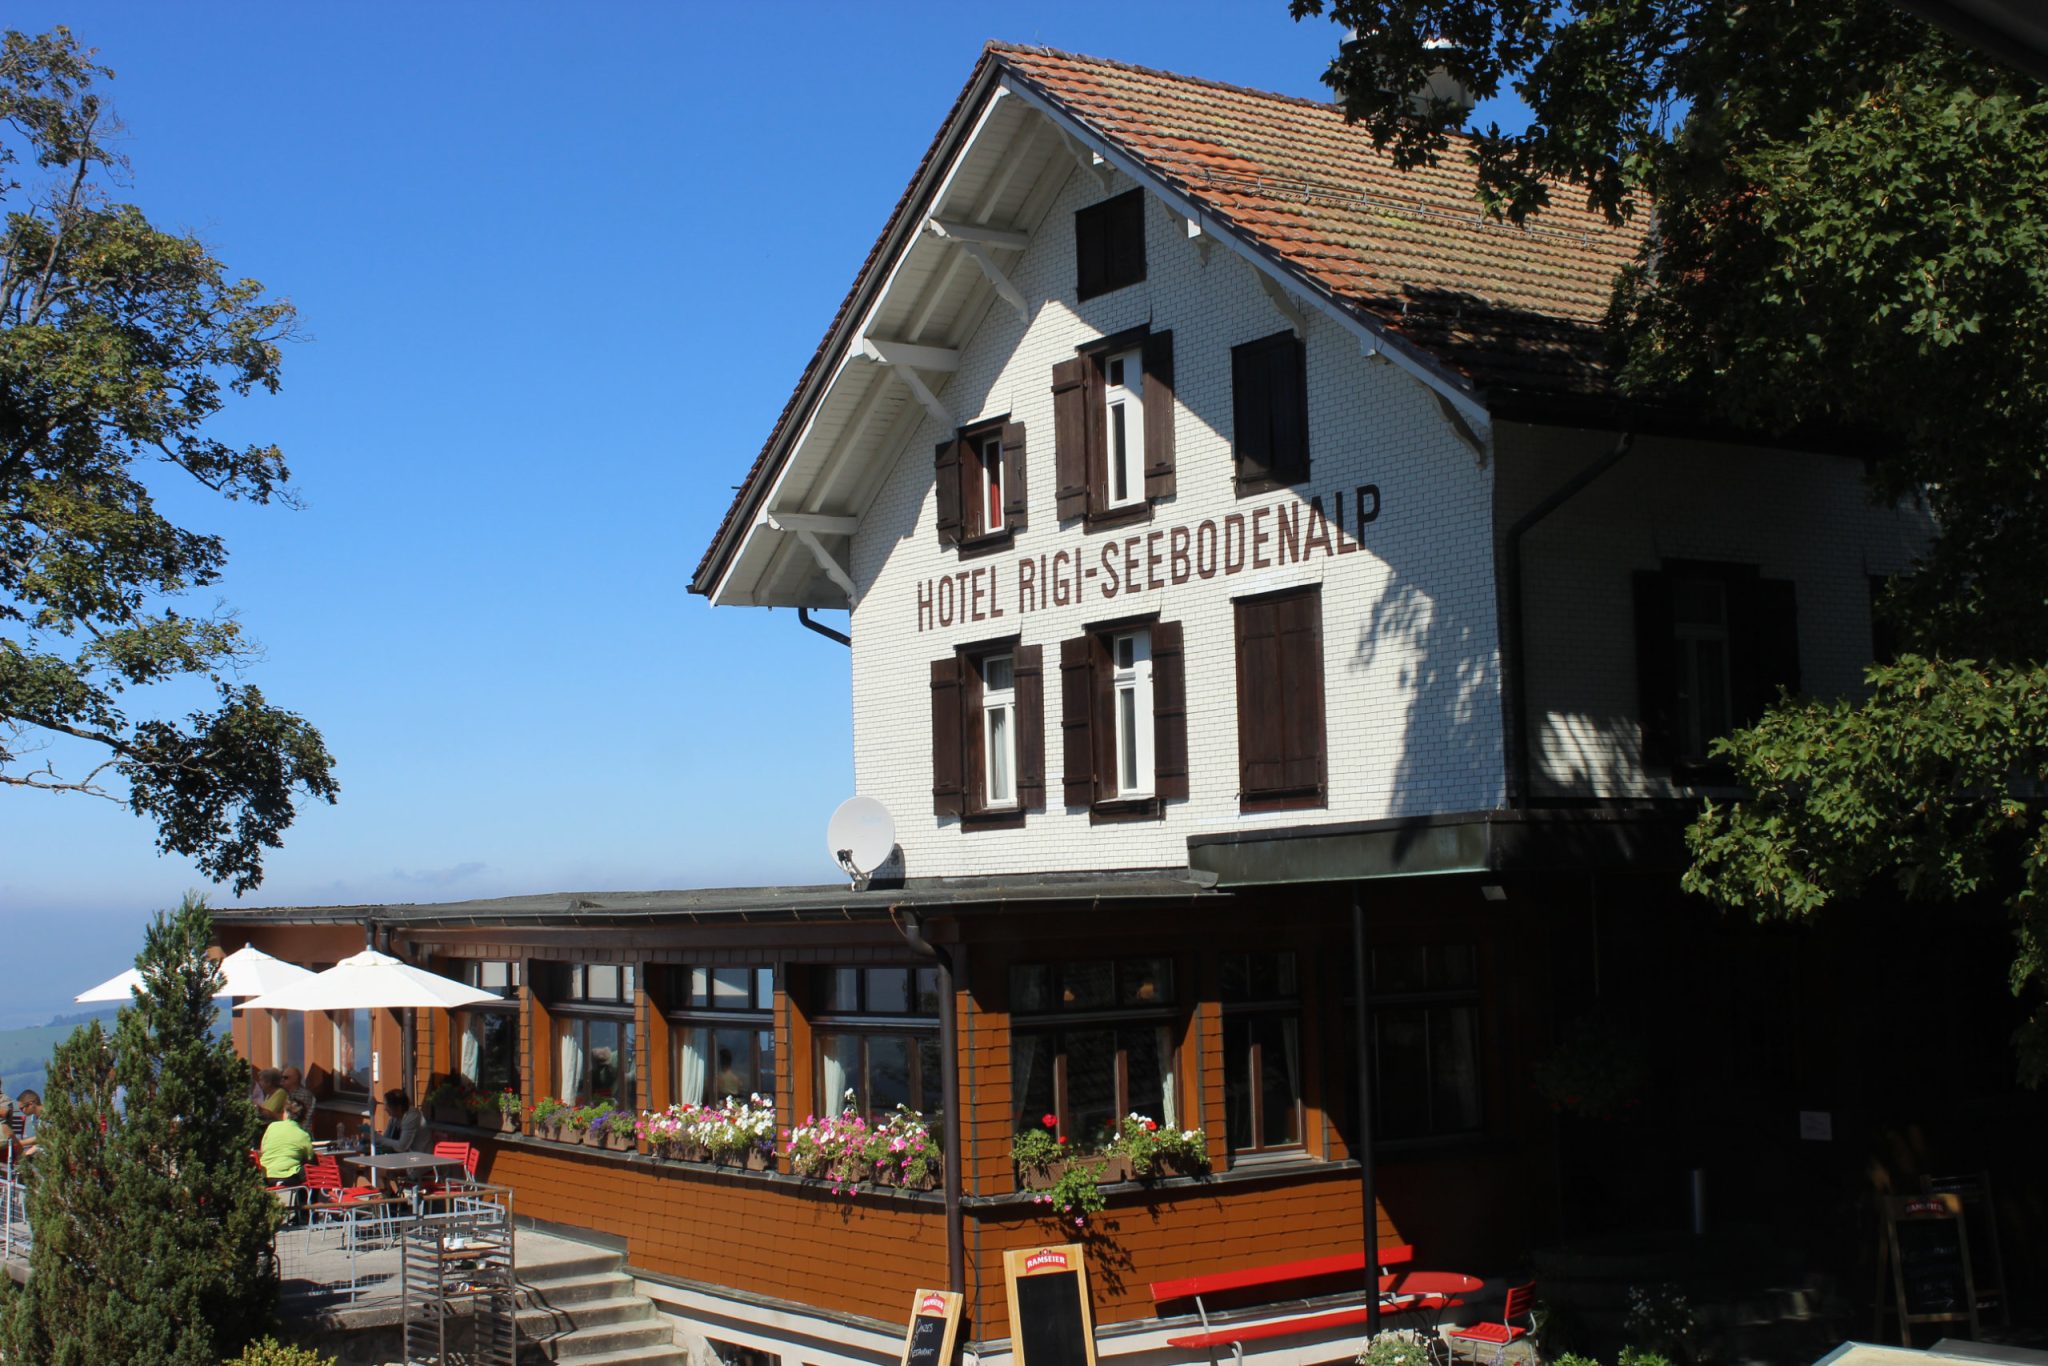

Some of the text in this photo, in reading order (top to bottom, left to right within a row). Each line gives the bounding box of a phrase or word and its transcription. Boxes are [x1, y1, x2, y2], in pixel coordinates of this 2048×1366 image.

[918, 484, 1381, 632] HOTEL RIGI-SEEBODENALP
[1026, 1255, 1066, 1269] RAMSEIER
